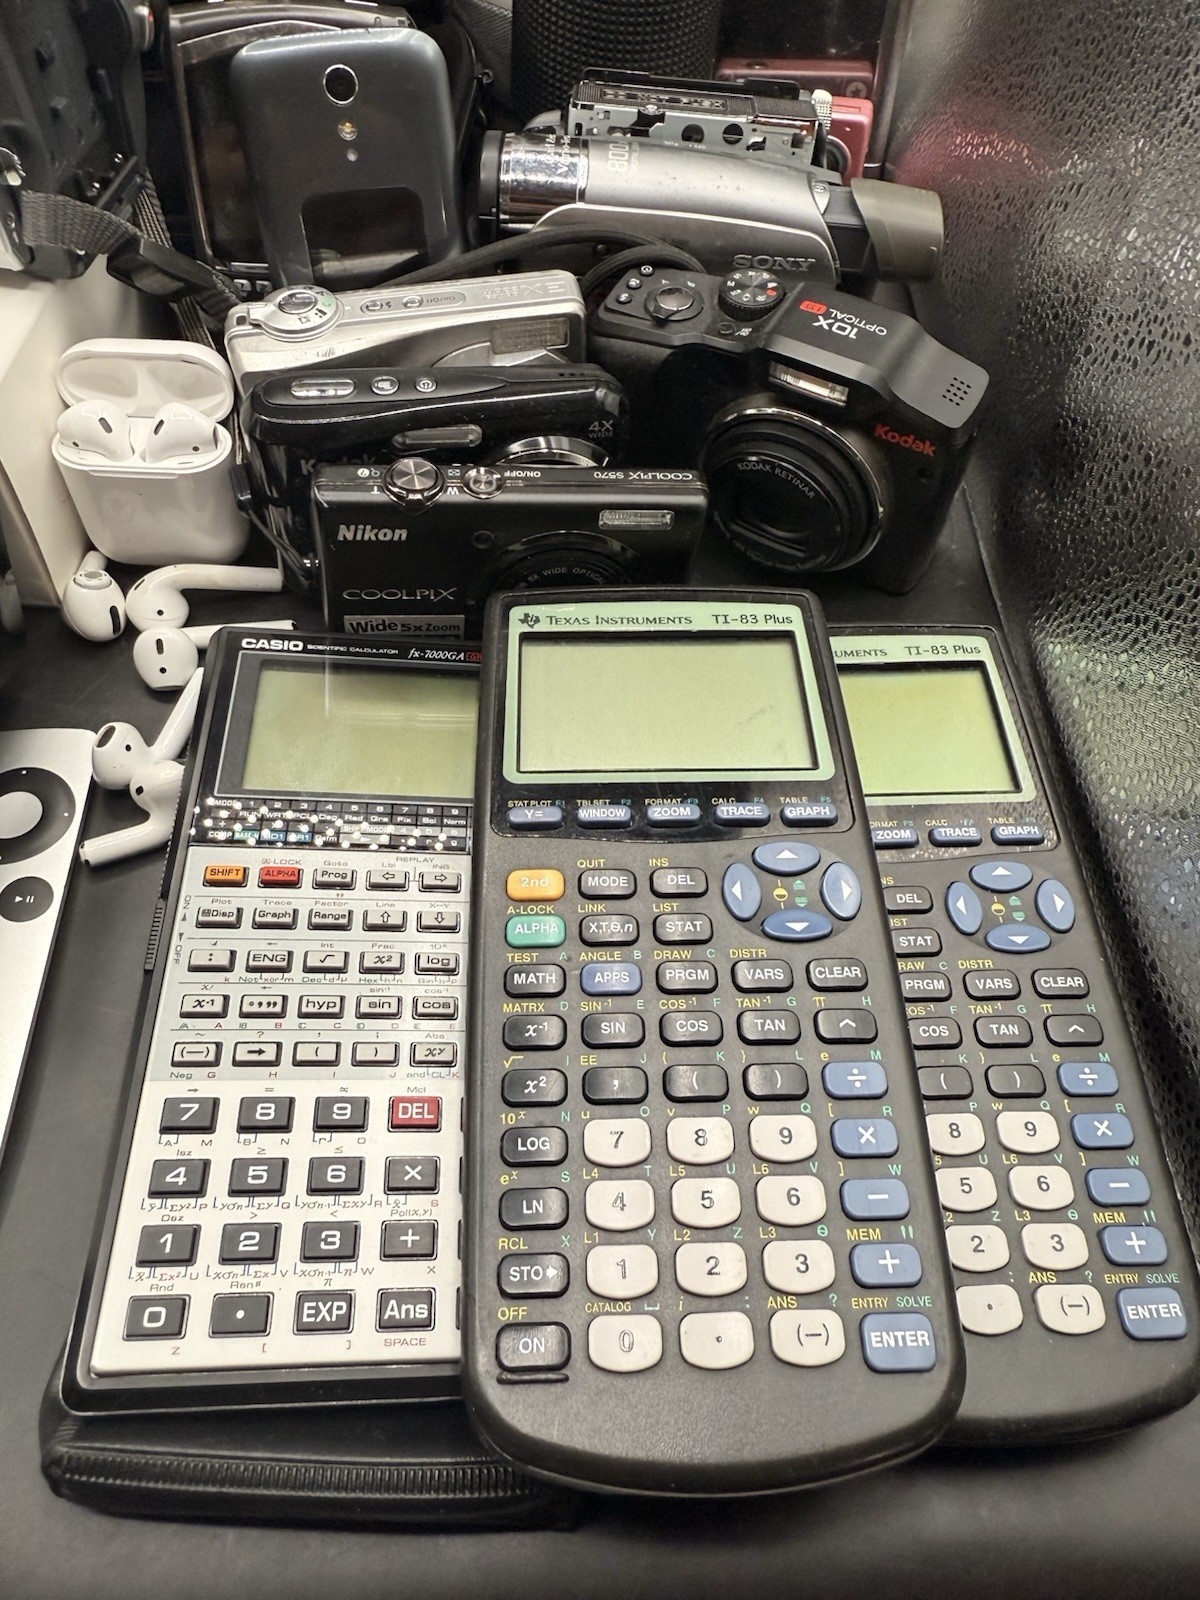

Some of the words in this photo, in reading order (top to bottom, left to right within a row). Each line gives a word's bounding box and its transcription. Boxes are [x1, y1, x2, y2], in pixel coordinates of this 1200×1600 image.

[733, 254, 816, 271] SONY
[812, 315, 858, 339] 10X
[829, 308, 888, 336] OPTICAL
[588, 420, 614, 432] 4X
[875, 423, 937, 457] Kodak
[594, 471, 624, 479] S570
[629, 471, 693, 480] COOLPIX
[738, 462, 772, 473] KODAK
[775, 468, 815, 499] RETINAR
[337, 524, 408, 541] Nikon
[542, 567, 567, 576] WIDE
[342, 587, 458, 602] COOLPIX
[545, 614, 590, 626] TEXAS
[595, 614, 692, 625] INSTRUMENTS
[712, 613, 759, 625] TI-83
[764, 613, 793, 625] Plus
[349, 616, 398, 634] Wide
[425, 622, 461, 632] Zoom
[241, 638, 304, 651] CASIO
[307, 644, 347, 652] SCIENTIFIC
[350, 646, 399, 654] CALCULATOR
[835, 649, 887, 658] UMENTS
[905, 646, 949, 656] TI-83
[954, 645, 981, 655] Plus
[645, 798, 682, 806] FORMAT
[779, 796, 808, 804] TABLE
[524, 809, 543, 819] Y=
[579, 808, 626, 818] WINDOW
[652, 807, 691, 816] ZOOM
[721, 806, 763, 816] TRACE
[787, 806, 830, 816] GRAPH
[876, 830, 912, 839] ZOOM
[939, 828, 978, 837] TRACE
[999, 827, 1039, 835] GRAPH
[577, 859, 606, 868] QUIT
[649, 858, 669, 867] INS
[209, 867, 241, 877] SHIFT
[264, 869, 297, 878] ALPHA
[321, 870, 347, 879] Prog
[520, 876, 549, 887] 2nd
[588, 877, 629, 887] MODE
[667, 875, 695, 885] DEL
[896, 894, 922, 903] DEL
[507, 905, 555, 914] A-LOCK
[578, 904, 606, 912] LINK
[653, 903, 679, 912] LIST
[258, 910, 292, 920] Graph
[313, 911, 347, 920] Range
[515, 923, 559, 934] ALPHA
[666, 922, 702, 932] STAT
[899, 936, 932, 947] STAT
[252, 953, 286, 963] ENG
[507, 953, 539, 963] TEST
[579, 952, 621, 961] ANGLE
[654, 950, 692, 959] DRAW
[730, 949, 767, 958] DISTR
[426, 954, 450, 967] log
[958, 960, 993, 969] DISTR
[594, 972, 629, 983] APPS
[666, 970, 709, 981] PRGM
[744, 969, 784, 980] VARS
[815, 967, 861, 978] CLEAR
[514, 973, 556, 984] MATH
[975, 979, 1012, 989] VARS
[1040, 977, 1084, 987] CLEAR
[905, 980, 945, 990] PRGM
[305, 1000, 337, 1011] hyp
[368, 1000, 391, 1009] sin
[422, 1001, 451, 1009] cos
[503, 1003, 545, 1013] MATRX
[601, 1022, 625, 1033] SIN
[676, 1020, 709, 1032] COS
[755, 1019, 786, 1031] TAN
[990, 1024, 1019, 1035] TAN
[919, 1026, 949, 1037] COS
[580, 1056, 597, 1065] EE
[170, 1071, 192, 1080] Neg
[178, 1103, 200, 1121] 7
[255, 1103, 276, 1120] 8
[332, 1102, 352, 1119] 9
[397, 1103, 435, 1119] DEL
[949, 1123, 961, 1138] 8
[1024, 1121, 1037, 1136] 9
[610, 1131, 625, 1149] 7
[695, 1128, 708, 1146] 8
[779, 1127, 793, 1145] 9
[518, 1138, 550, 1150] LOG
[1003, 1154, 1018, 1164] L6
[247, 1165, 269, 1184] 5
[326, 1165, 346, 1183] 6
[583, 1169, 598, 1179] L4
[669, 1166, 685, 1176] L5
[753, 1164, 769, 1174] L6
[165, 1167, 187, 1185] 4
[960, 1177, 972, 1194] 5
[1037, 1175, 1050, 1192] 6
[612, 1192, 626, 1211] 4
[701, 1190, 714, 1209] 5
[786, 1187, 801, 1206] 6
[522, 1201, 543, 1214] LN
[1015, 1211, 1030, 1221] L3
[1093, 1212, 1126, 1224] MEM
[584, 1233, 599, 1243] L1
[674, 1230, 690, 1241] L2
[760, 1228, 776, 1238] L3
[846, 1229, 881, 1241] MEM
[159, 1234, 172, 1253] 1
[238, 1232, 260, 1251] 2
[320, 1230, 341, 1250] 3
[498, 1239, 528, 1249] RCL
[970, 1235, 985, 1253] 2
[1050, 1234, 1065, 1252] 3
[617, 1259, 626, 1279] 1
[706, 1256, 721, 1275] 2
[795, 1254, 809, 1273] 3
[510, 1267, 543, 1281] STO
[1029, 1272, 1057, 1284] ANS
[1104, 1274, 1139, 1284] ENTRY
[1146, 1273, 1180, 1283] SOLVE
[150, 1284, 175, 1292] Rnd
[585, 1303, 631, 1312] CATALOG
[767, 1297, 797, 1308] ANS
[852, 1298, 888, 1308] ENTRY
[896, 1297, 932, 1307] SOLVE
[302, 1301, 347, 1322] EXP
[384, 1299, 428, 1320] Ans
[498, 1307, 527, 1320] OFF
[1127, 1303, 1182, 1320] ENTER
[384, 1338, 426, 1346] SPACE
[871, 1332, 930, 1348] ENTER
[519, 1339, 545, 1354] ON
